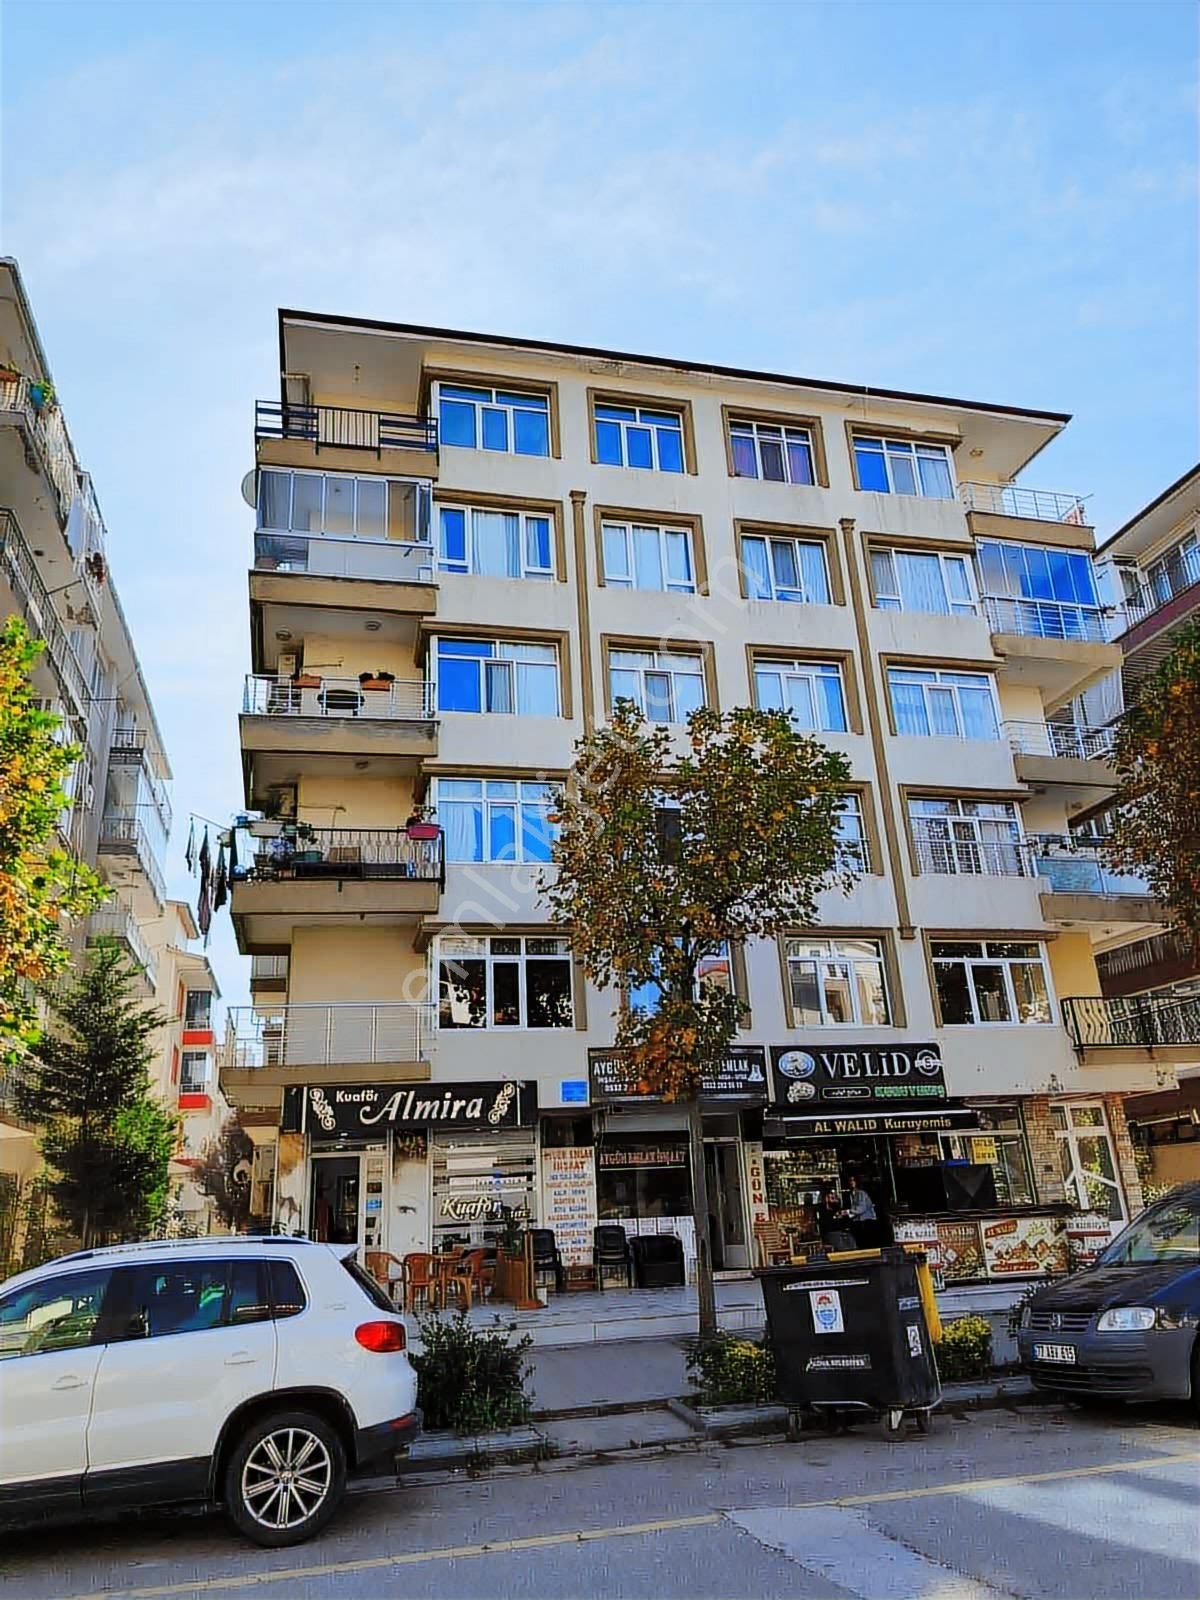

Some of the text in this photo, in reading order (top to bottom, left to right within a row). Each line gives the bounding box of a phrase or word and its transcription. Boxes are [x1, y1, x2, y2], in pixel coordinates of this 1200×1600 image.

[336, 1089, 379, 1103] Kuaför
[359, 1090, 484, 1125] Almira
[814, 1121, 832, 1134] AL
[835, 1118, 877, 1132] WALID
